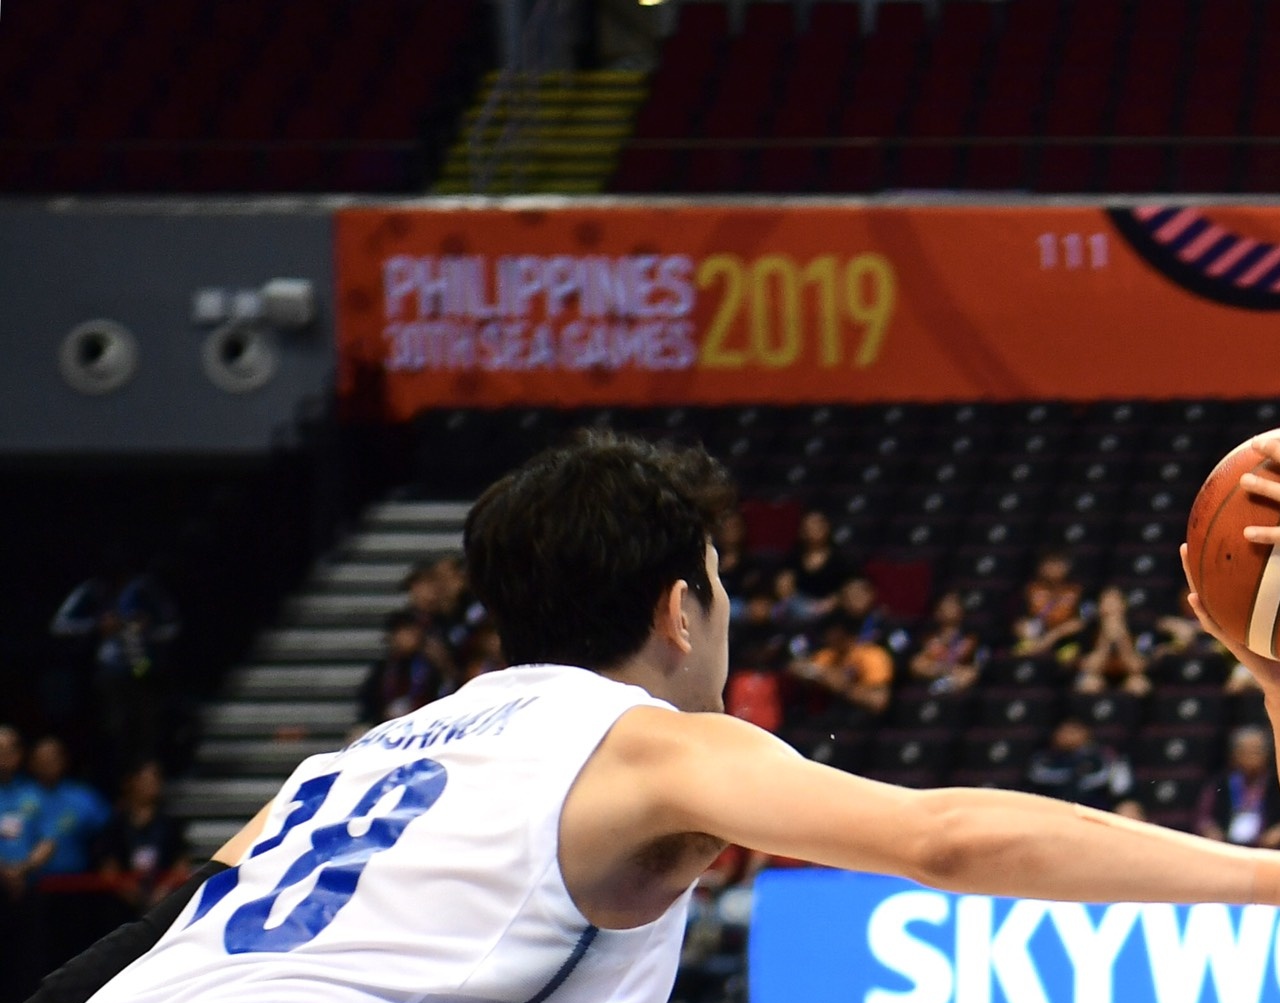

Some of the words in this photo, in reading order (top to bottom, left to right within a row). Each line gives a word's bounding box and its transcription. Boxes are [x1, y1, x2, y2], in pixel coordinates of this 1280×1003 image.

[384, 254, 697, 318] PHILIPPINES
[699, 252, 896, 368] 2019
[384, 321, 474, 370] 30TH
[479, 321, 555, 370] SEA
[559, 321, 697, 370] GAMES
[181, 756, 448, 955] 18
